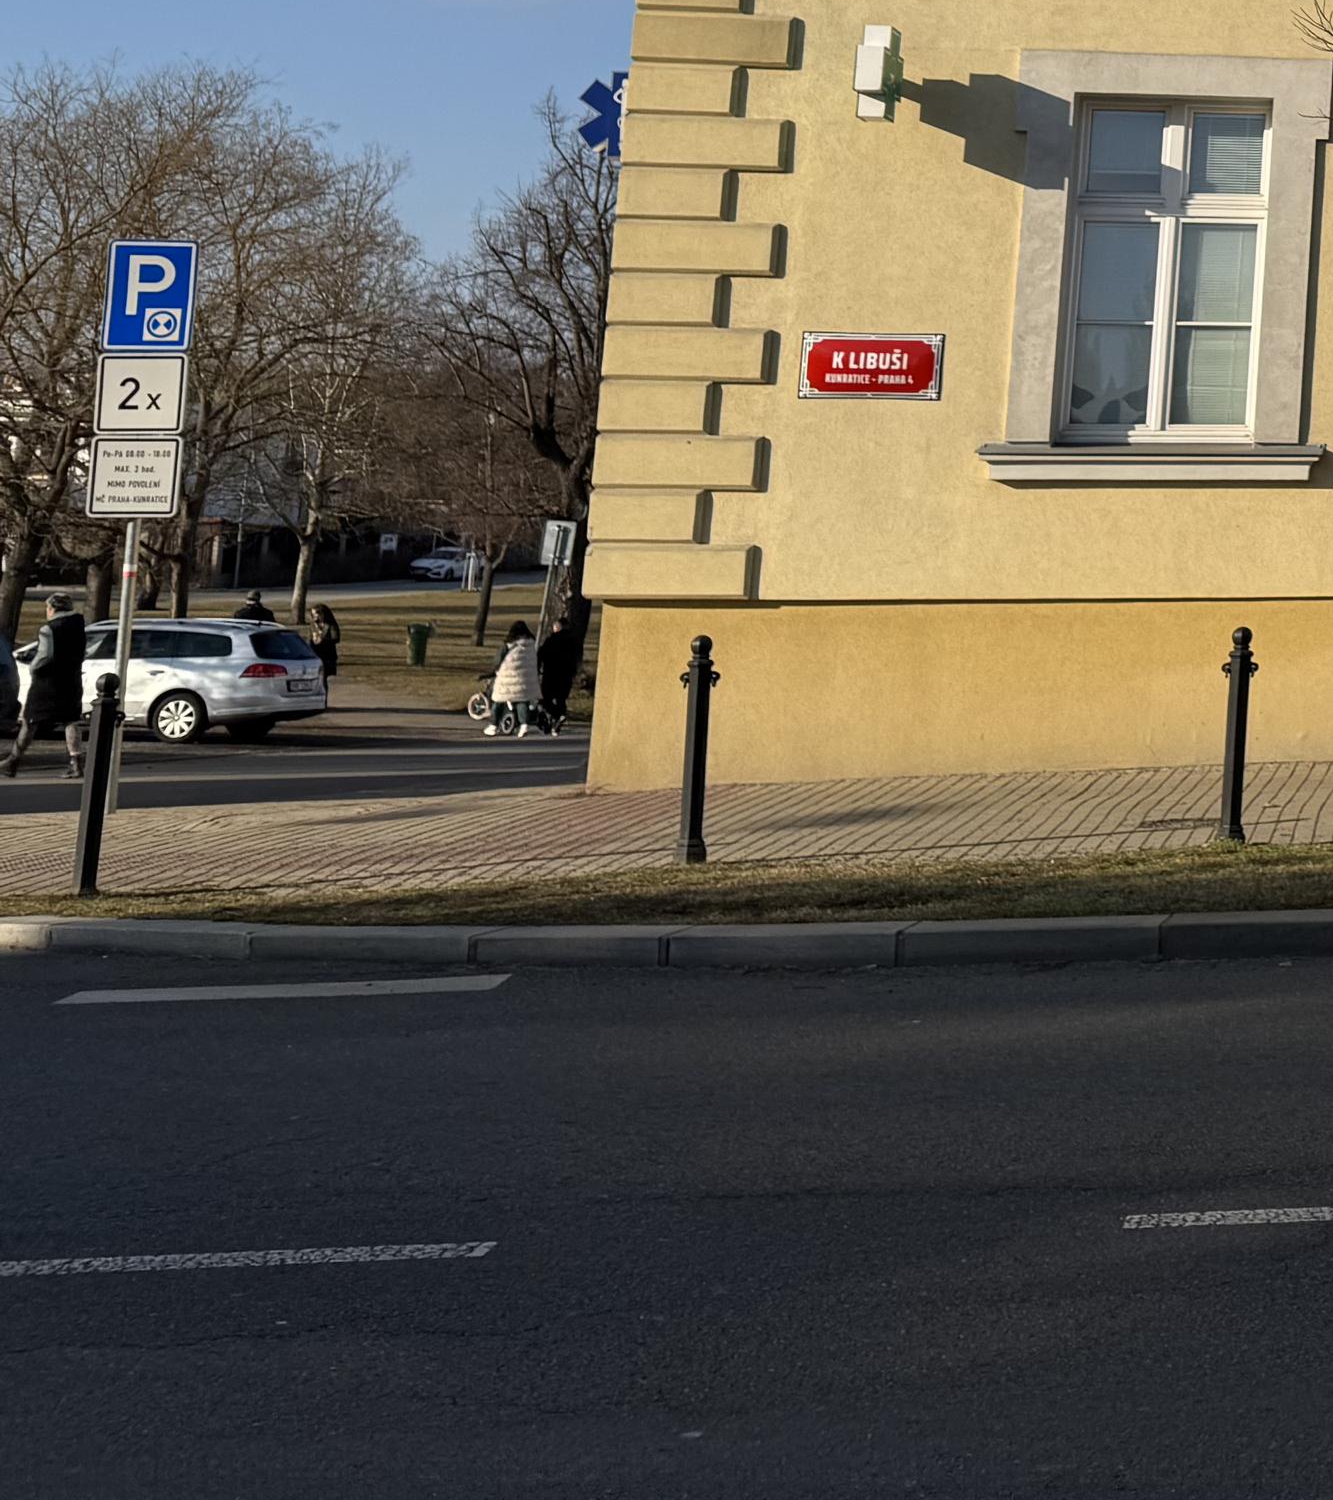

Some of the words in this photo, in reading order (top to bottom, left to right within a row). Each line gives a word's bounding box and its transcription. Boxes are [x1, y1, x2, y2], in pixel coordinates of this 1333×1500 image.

[125, 254, 176, 316] P
[831, 351, 846, 370] K
[849, 348, 909, 371] LIBUŠI
[824, 373, 871, 385] KUNRATICE
[877, 374, 908, 385] PRAHA
[907, 375, 914, 385] 4
[107, 480, 126, 488] MIMO
[128, 479, 161, 489] POVOLENÍ
